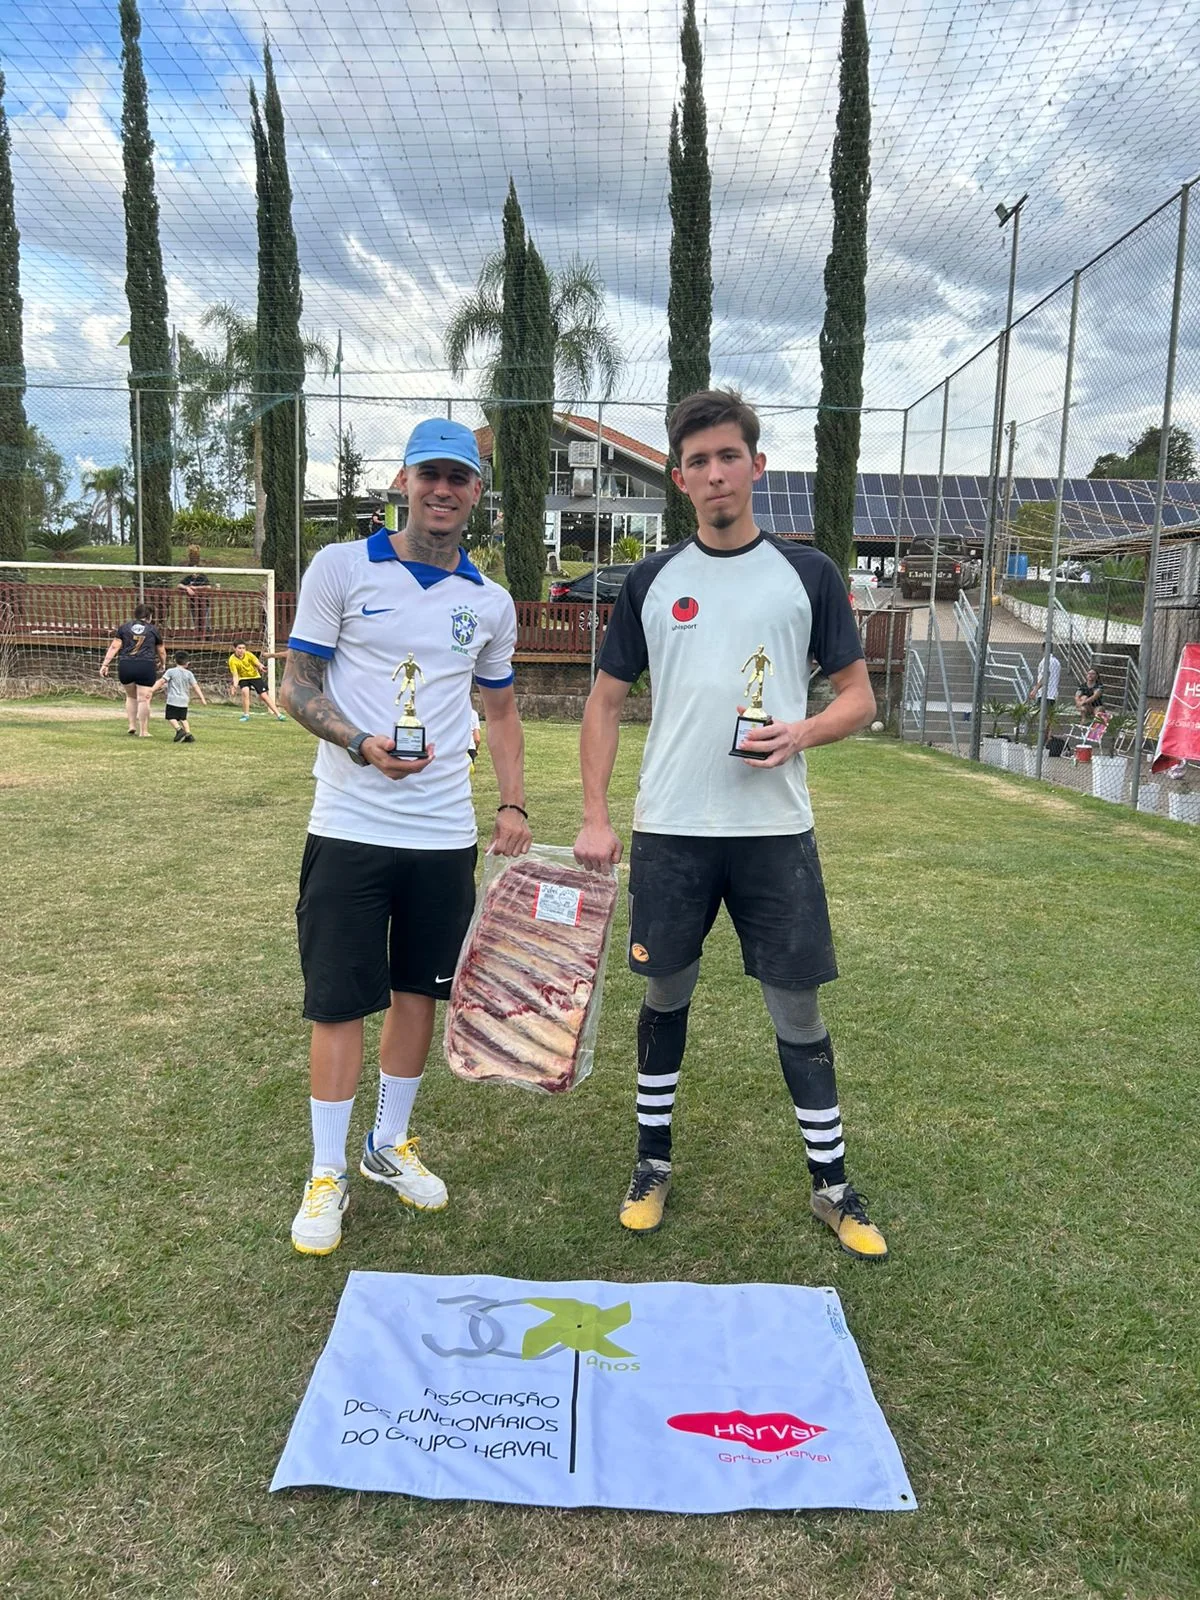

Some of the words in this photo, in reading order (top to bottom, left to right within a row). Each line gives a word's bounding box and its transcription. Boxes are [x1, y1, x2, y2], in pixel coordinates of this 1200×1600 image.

[130, 635, 146, 655] 7
[586, 1355, 640, 1371] Anos
[424, 1387, 560, 1408] ASSOCIAÇÃO
[343, 1398, 392, 1419] DOS
[397, 1408, 559, 1432] FUNCIONÁRIOS
[713, 1423, 821, 1440] Herval
[341, 1428, 379, 1446] DO
[385, 1426, 467, 1452] GRUPO
[474, 1441, 558, 1460] HERVAL
[776, 1449, 832, 1462] Herval
